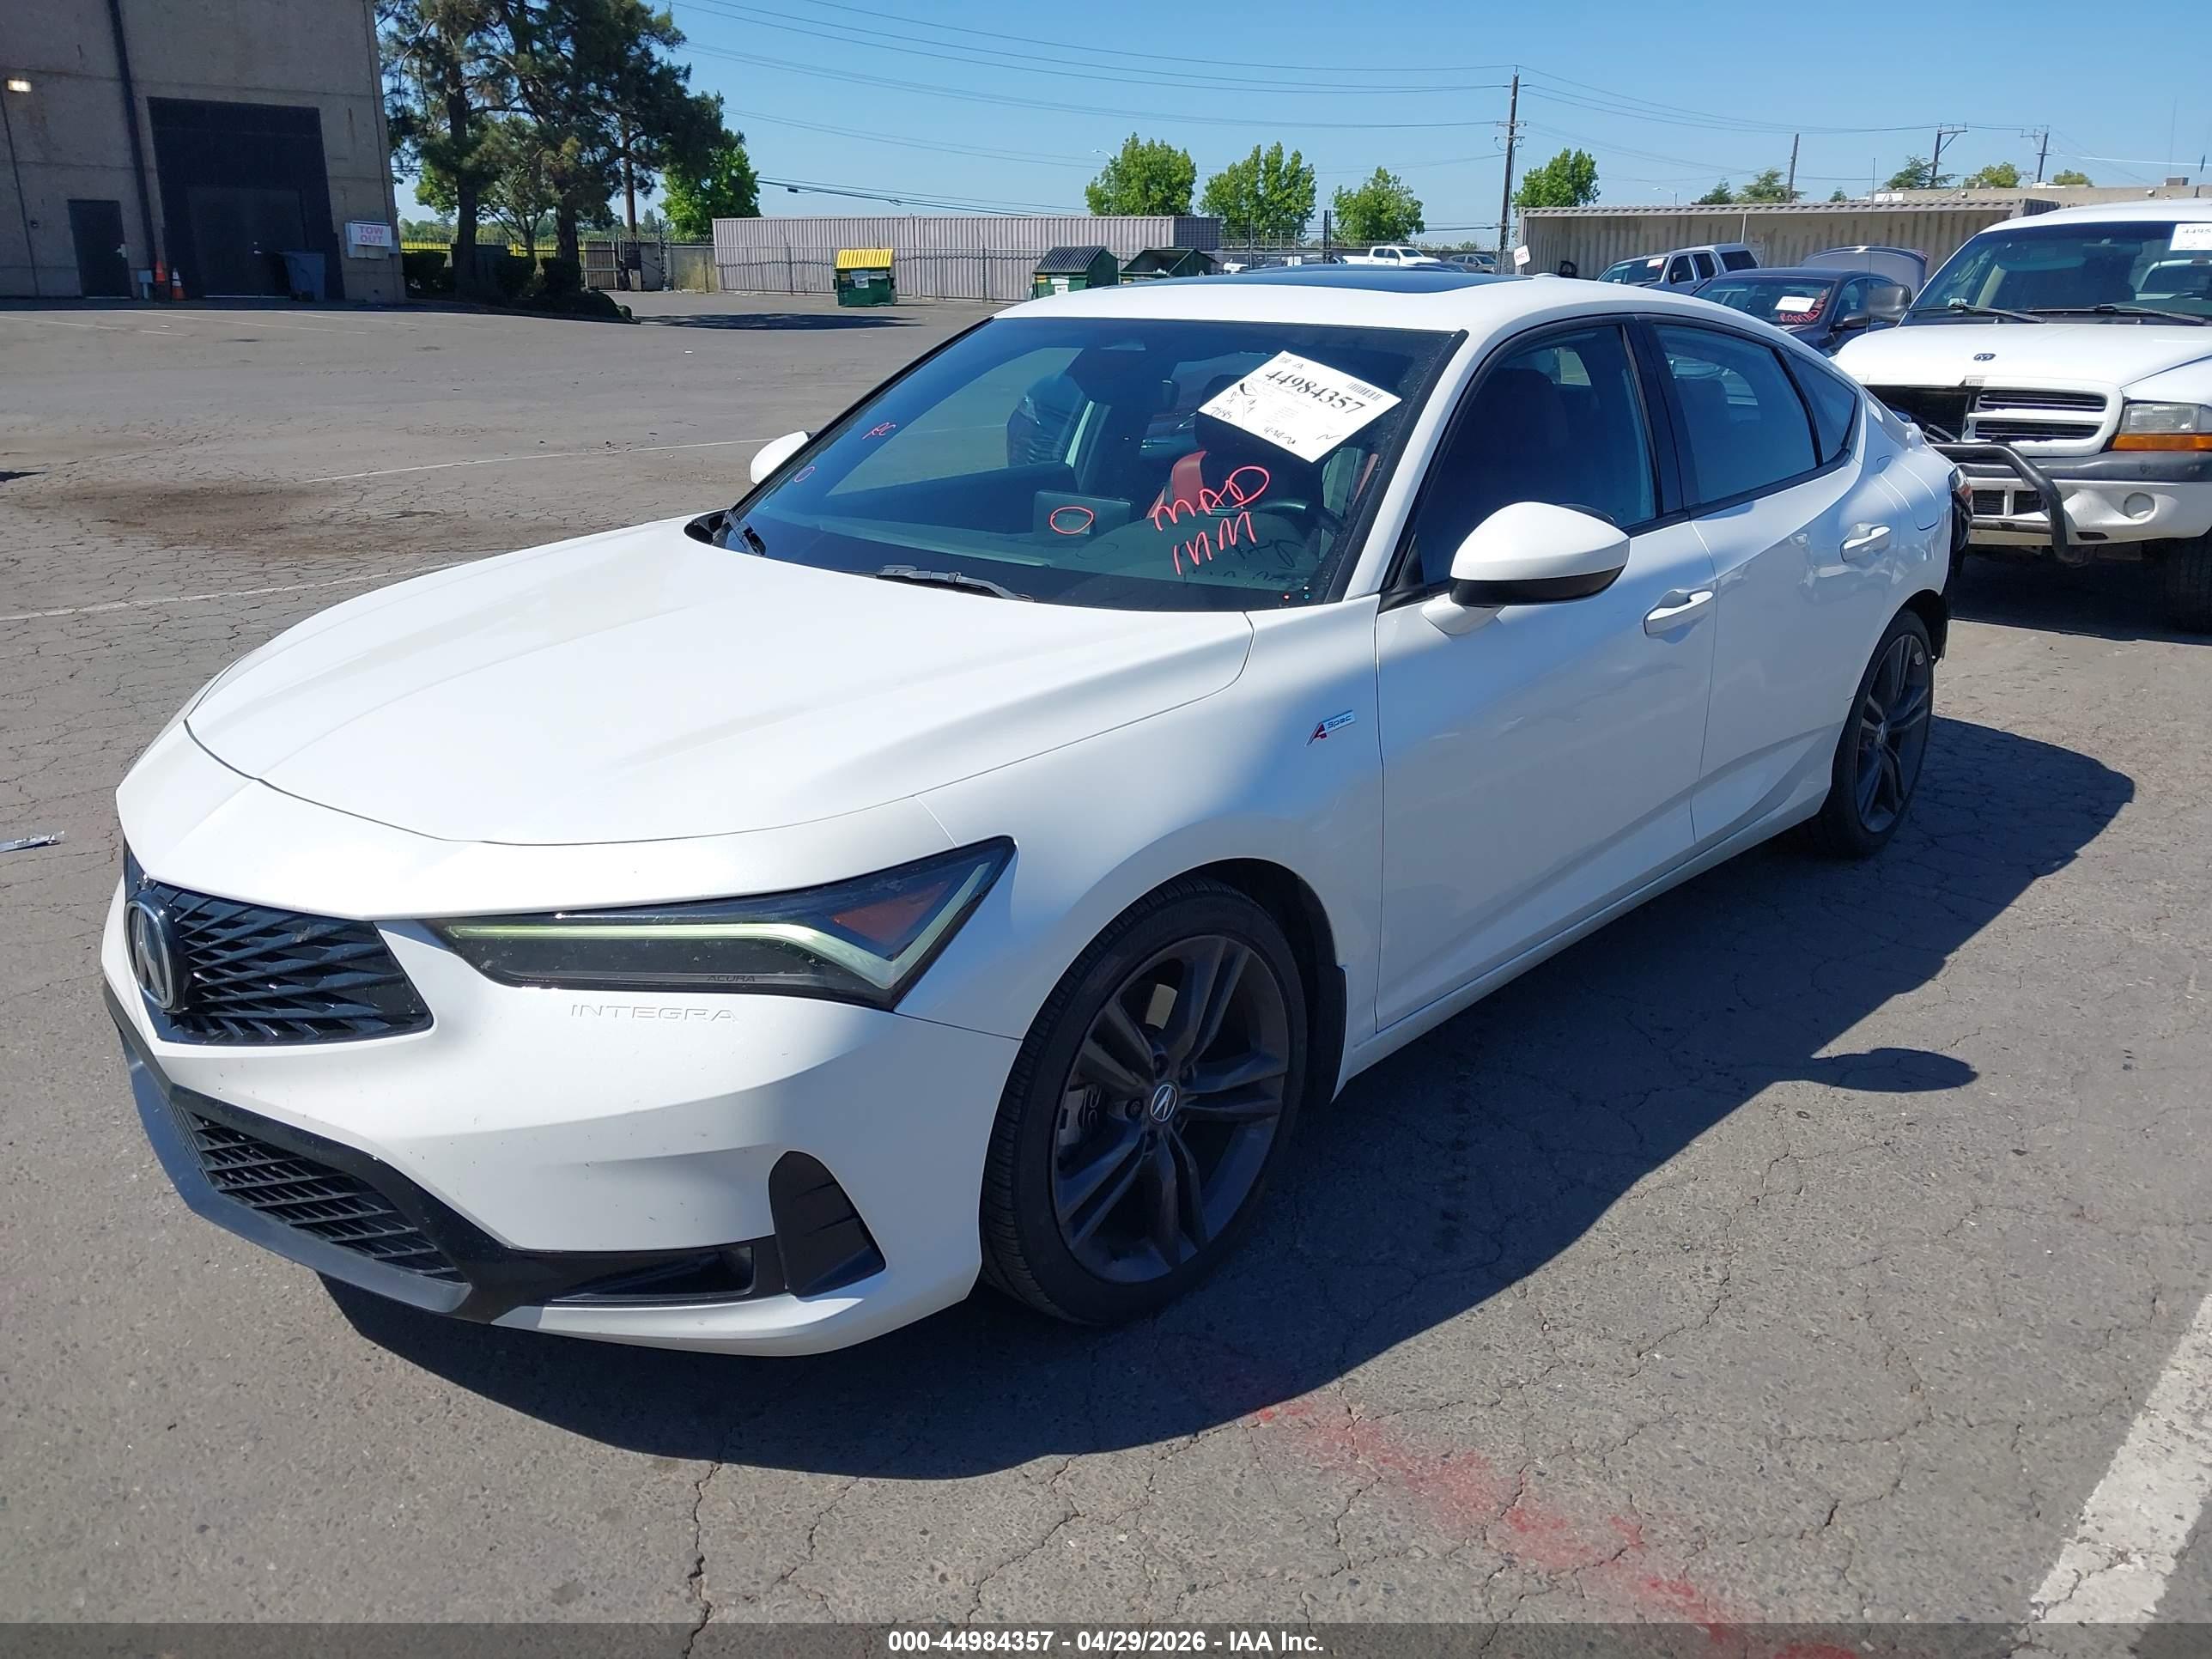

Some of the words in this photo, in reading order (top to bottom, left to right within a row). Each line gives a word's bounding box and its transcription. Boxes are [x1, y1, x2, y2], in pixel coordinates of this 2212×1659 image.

[358, 226, 384, 234] TOW
[361, 234, 382, 243] OUT
[1265, 370, 1366, 414] 44984357
[707, 974, 756, 983] ACURA
[572, 1005, 737, 1022] INTEGRA
